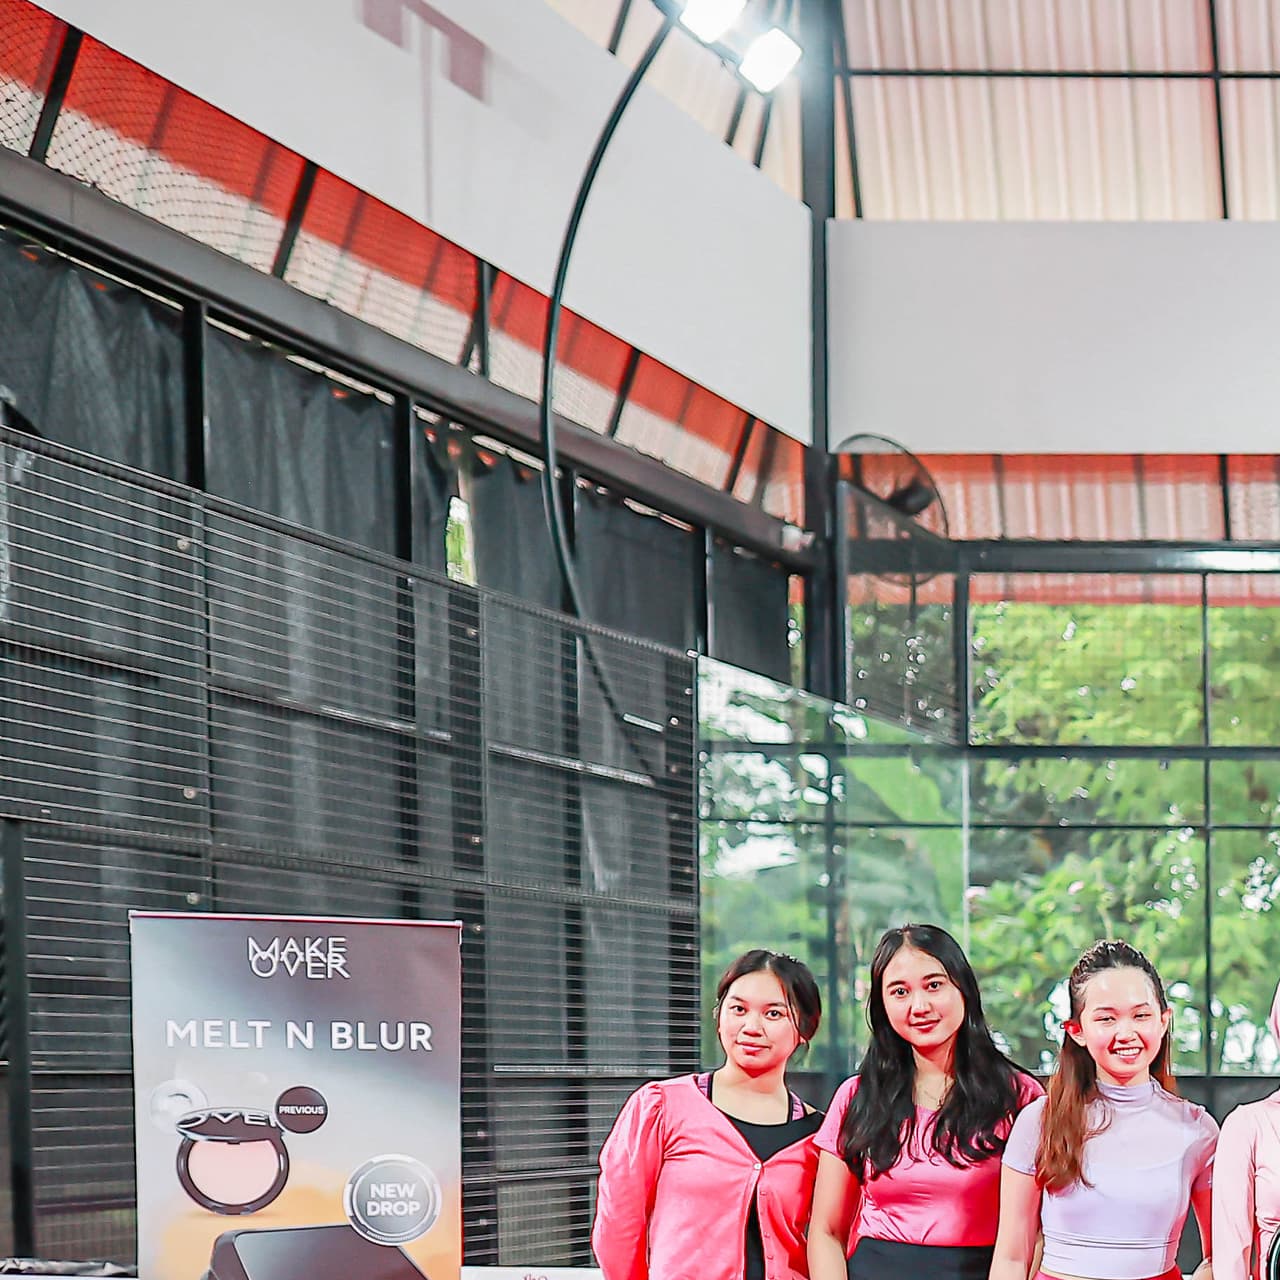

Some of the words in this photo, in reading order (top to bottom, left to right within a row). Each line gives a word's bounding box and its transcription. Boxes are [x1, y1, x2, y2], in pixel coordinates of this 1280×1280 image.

[249, 937, 347, 961] MAKE
[250, 951, 350, 978] OVER
[166, 1020, 272, 1049] MELT
[286, 1021, 314, 1050] N
[331, 1022, 433, 1051] BLUR
[278, 1104, 326, 1116] PREVIOUS
[370, 1183, 416, 1199] NEW
[366, 1201, 421, 1217] DROP
